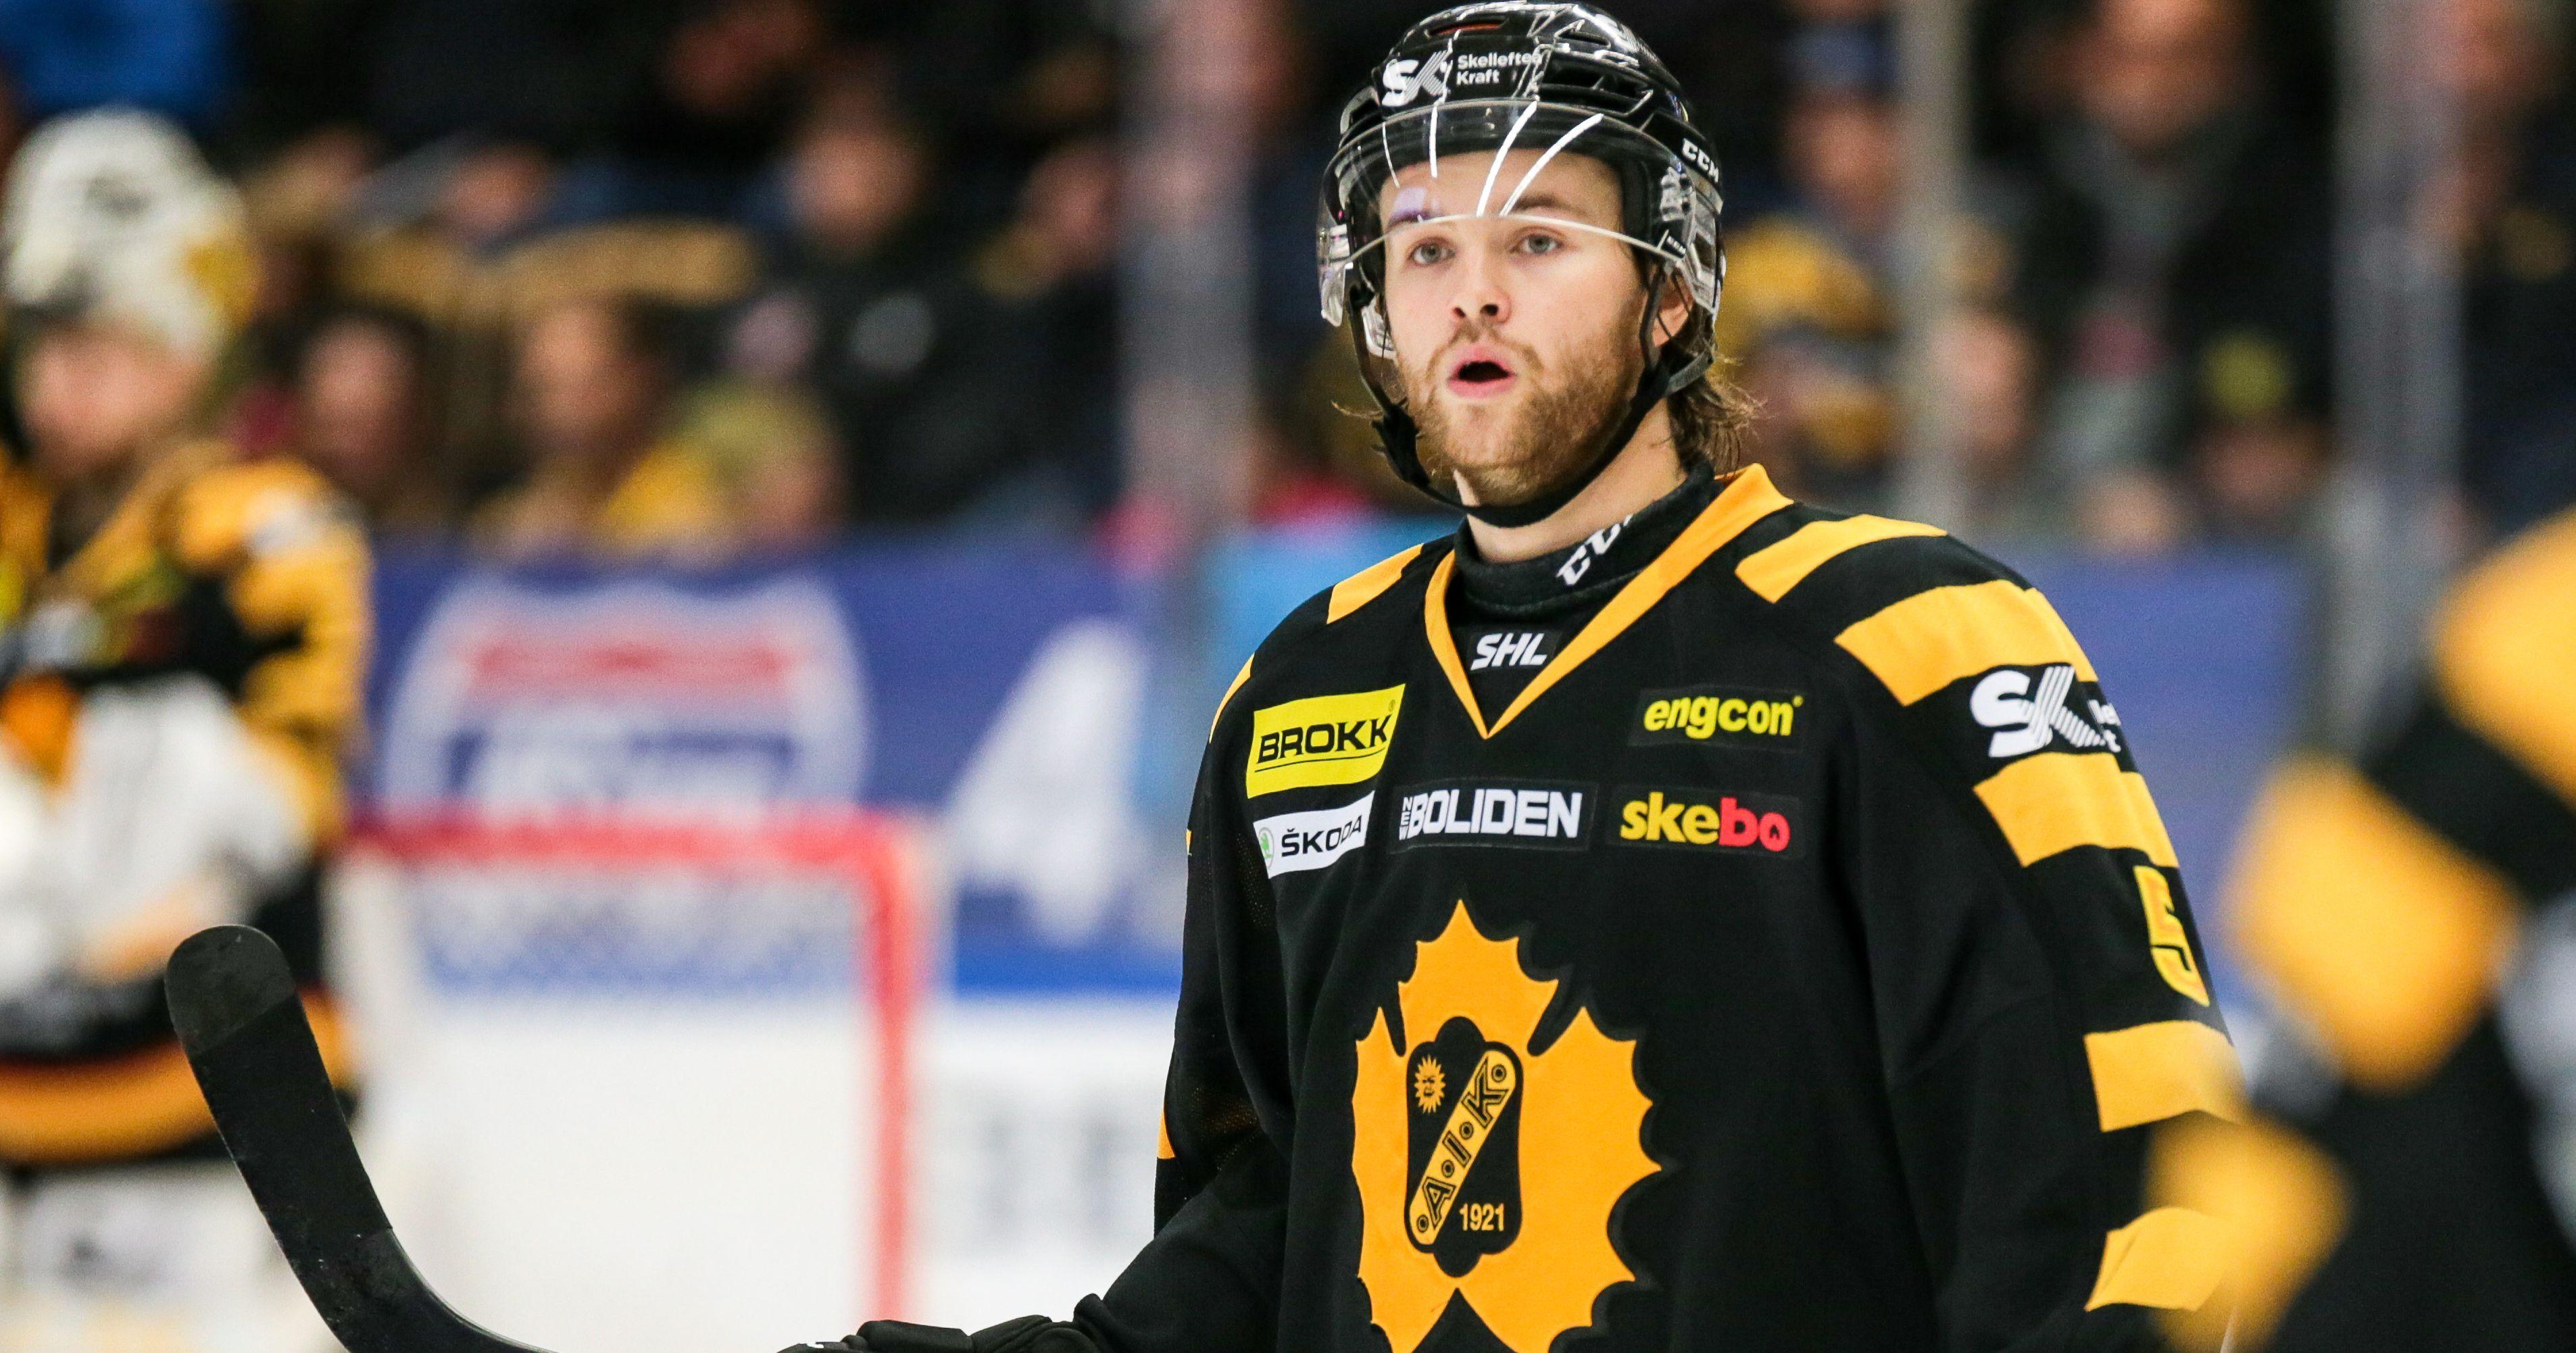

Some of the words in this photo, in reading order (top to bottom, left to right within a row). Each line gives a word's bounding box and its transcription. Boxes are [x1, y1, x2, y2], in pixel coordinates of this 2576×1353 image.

[1456, 69, 1500, 86] Kraft
[1681, 138, 1720, 183] CCM
[1556, 513, 1634, 586] CC
[1470, 633, 1548, 670] SHL
[1256, 714, 1393, 764] BROKK
[1643, 696, 1794, 739] engcon
[1407, 789, 1583, 839] BOLIDEN
[1620, 791, 1791, 852] skebo
[1281, 815, 1363, 858] ŠKODA
[1458, 1203, 1505, 1232] 1921
